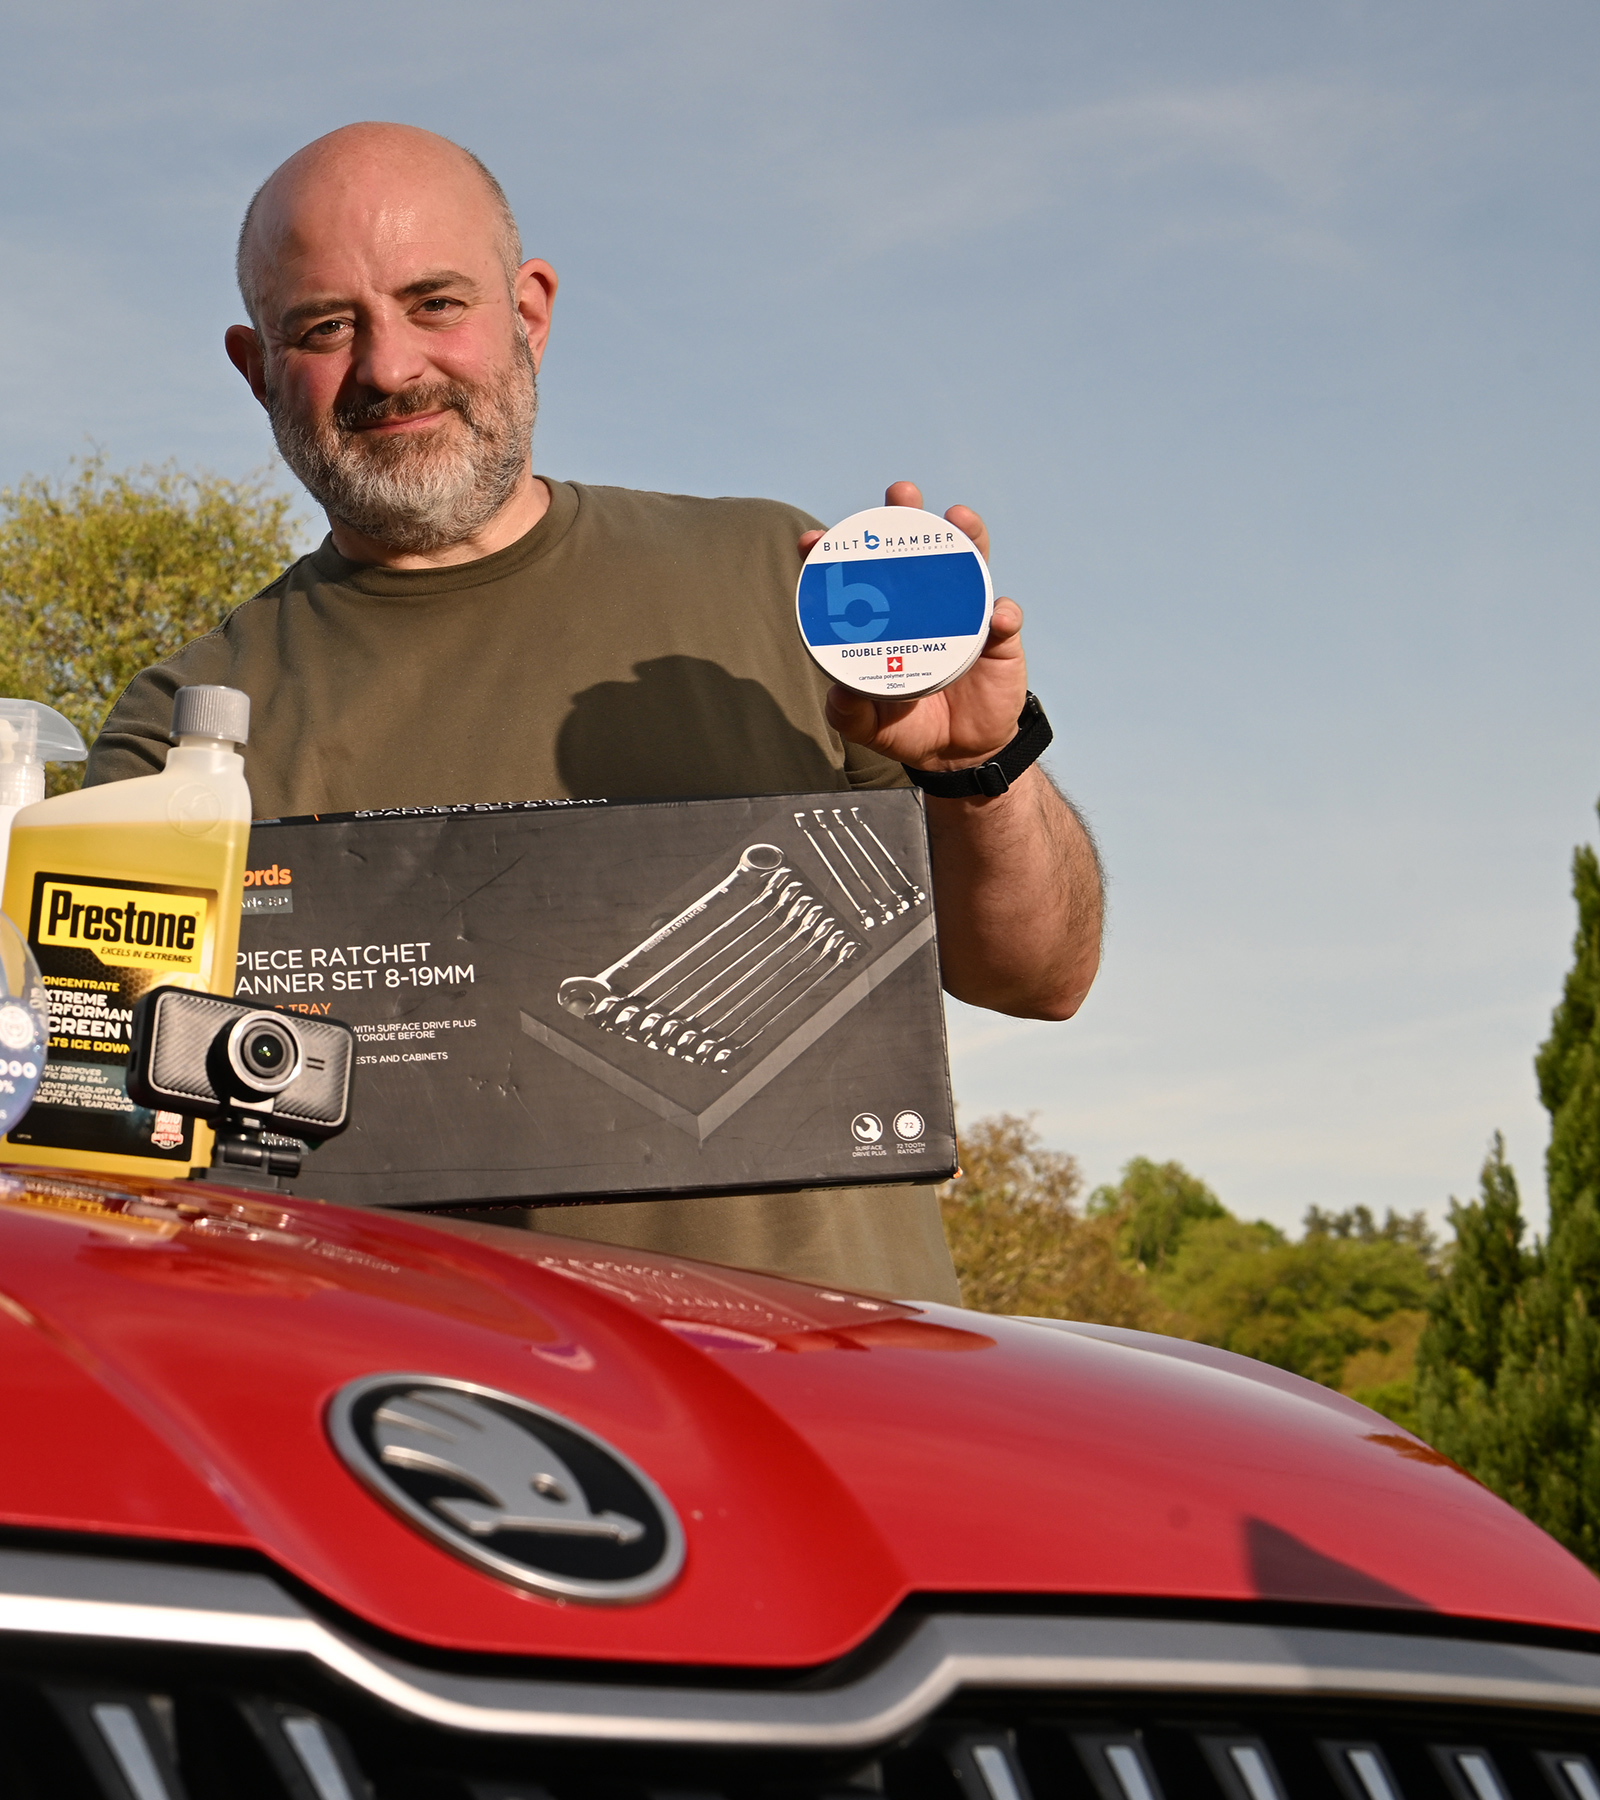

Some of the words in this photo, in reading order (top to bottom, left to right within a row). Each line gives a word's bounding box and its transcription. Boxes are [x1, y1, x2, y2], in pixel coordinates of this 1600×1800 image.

[823, 540, 860, 551] BILT
[885, 532, 954, 546] HAMBER
[886, 544, 955, 553] LABORATORIES
[841, 647, 883, 658] DOUBLE
[886, 642, 947, 655] SPEED-WAX
[883, 672, 905, 680] polymer
[886, 682, 906, 690] 250ml
[243, 864, 292, 887] ords
[48, 889, 196, 950] Prestone
[671, 903, 708, 932] ADVANCED
[100, 947, 131, 957] EXCELS
[133, 950, 142, 959] IN
[144, 952, 193, 964] EXTREMES
[236, 950, 303, 970] PIECE
[311, 942, 431, 967] RATCHET
[235, 972, 324, 996] ANNER
[332, 970, 377, 990] SET
[385, 964, 475, 988] 8-19MM
[47, 1002, 133, 1022] ERFORMAN
[289, 1003, 331, 1015] TRAY
[352, 1025, 375, 1034] WITH
[377, 1022, 420, 1033] SURFACE
[422, 1020, 451, 1030] DRIVE
[452, 1019, 477, 1028] PLUS
[357, 1032, 396, 1042] TORQUE
[398, 1030, 435, 1040] BEFORE
[47, 1036, 69, 1048] LTS
[71, 1039, 92, 1051] ICE
[356, 1056, 377, 1064] ESTS
[379, 1054, 400, 1063] AND
[402, 1052, 448, 1062] CABINETS
[44, 1064, 60, 1073] KLY
[61, 1066, 102, 1076] REMOVES
[60, 1072, 77, 1081] DIRT
[87, 1076, 108, 1084] SALT
[40, 1081, 67, 1090] VENTS
[67, 1083, 114, 1095] HEADLIGHT
[41, 1088, 74, 1099] DAZZLE
[74, 1092, 92, 1100] FOR
[62, 1098, 79, 1107] ALL
[80, 1100, 103, 1109] YEAR
[103, 1102, 135, 1112] ROUND
[158, 1111, 180, 1124] AUTO
[855, 1144, 883, 1152] SURFACE
